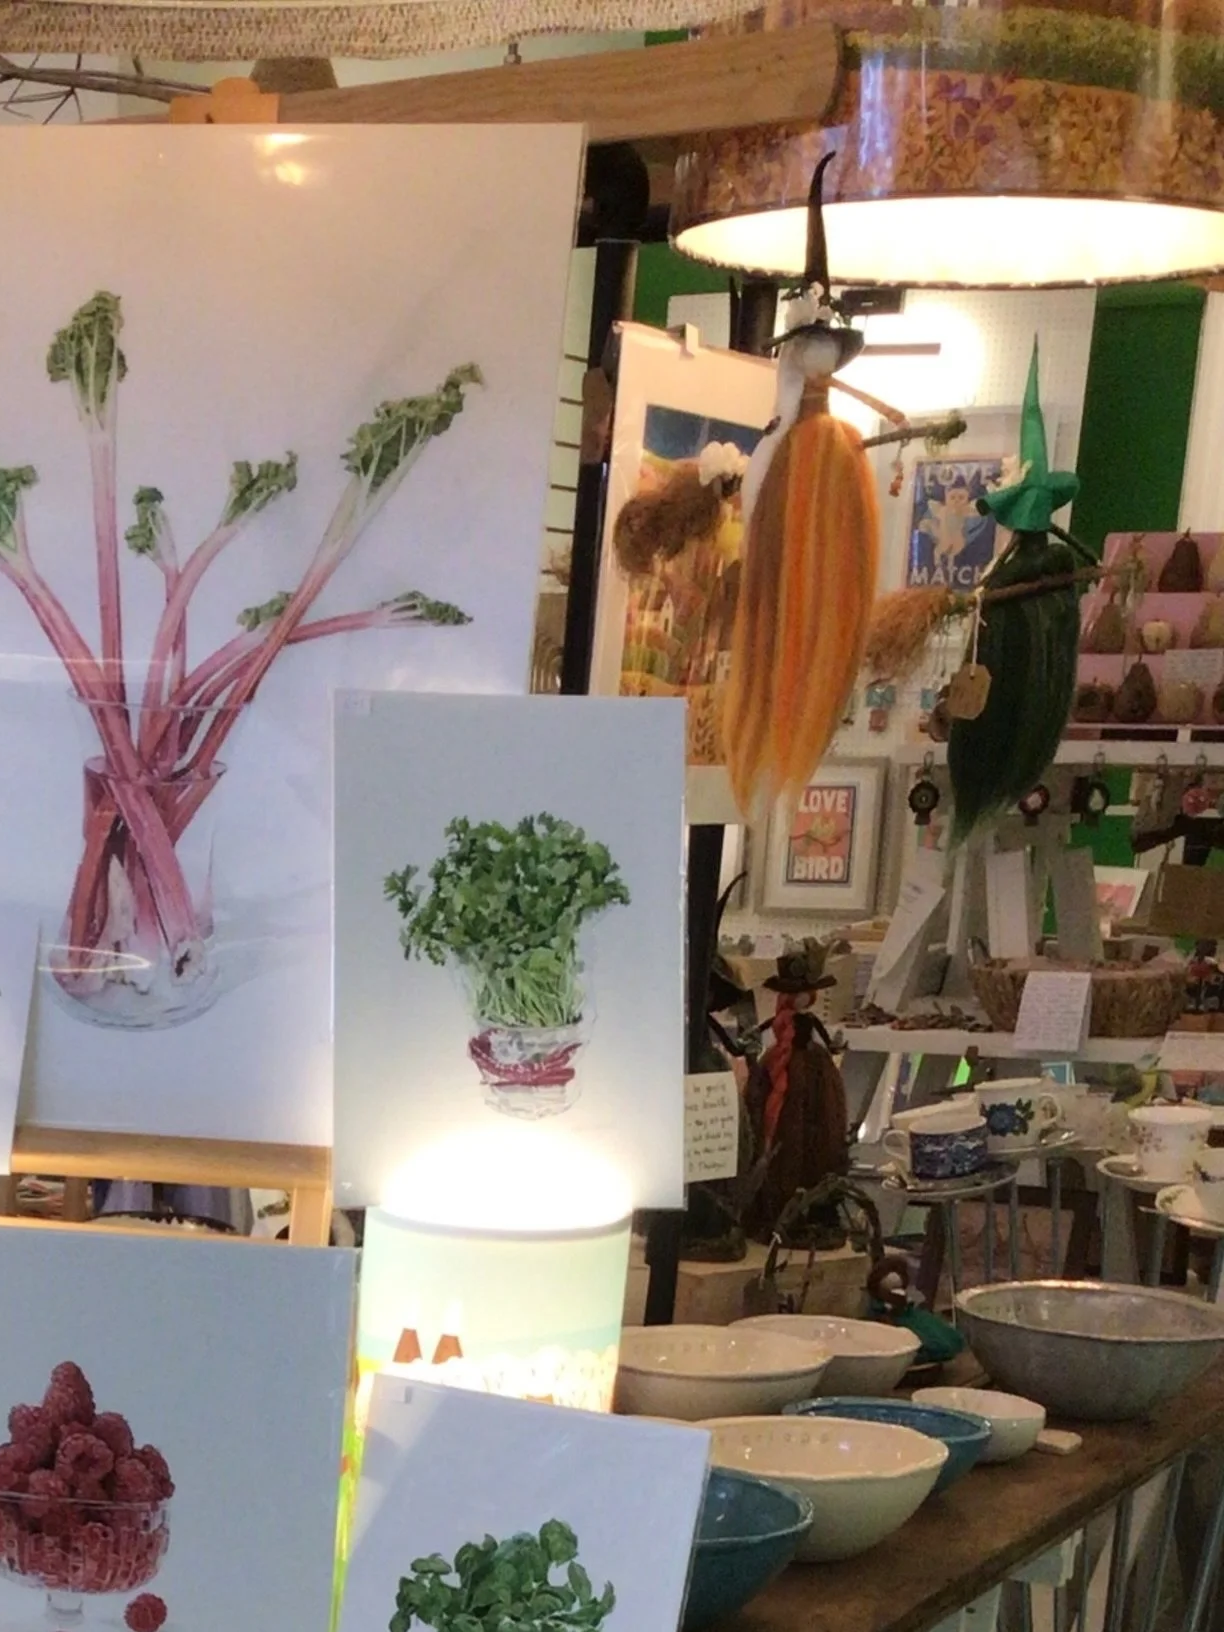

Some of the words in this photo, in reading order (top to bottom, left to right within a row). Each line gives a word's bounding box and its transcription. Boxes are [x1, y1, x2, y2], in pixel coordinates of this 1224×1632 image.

[923, 463, 993, 486] LOVE
[798, 789, 848, 814] LOVE
[793, 856, 844, 881] BIRD
